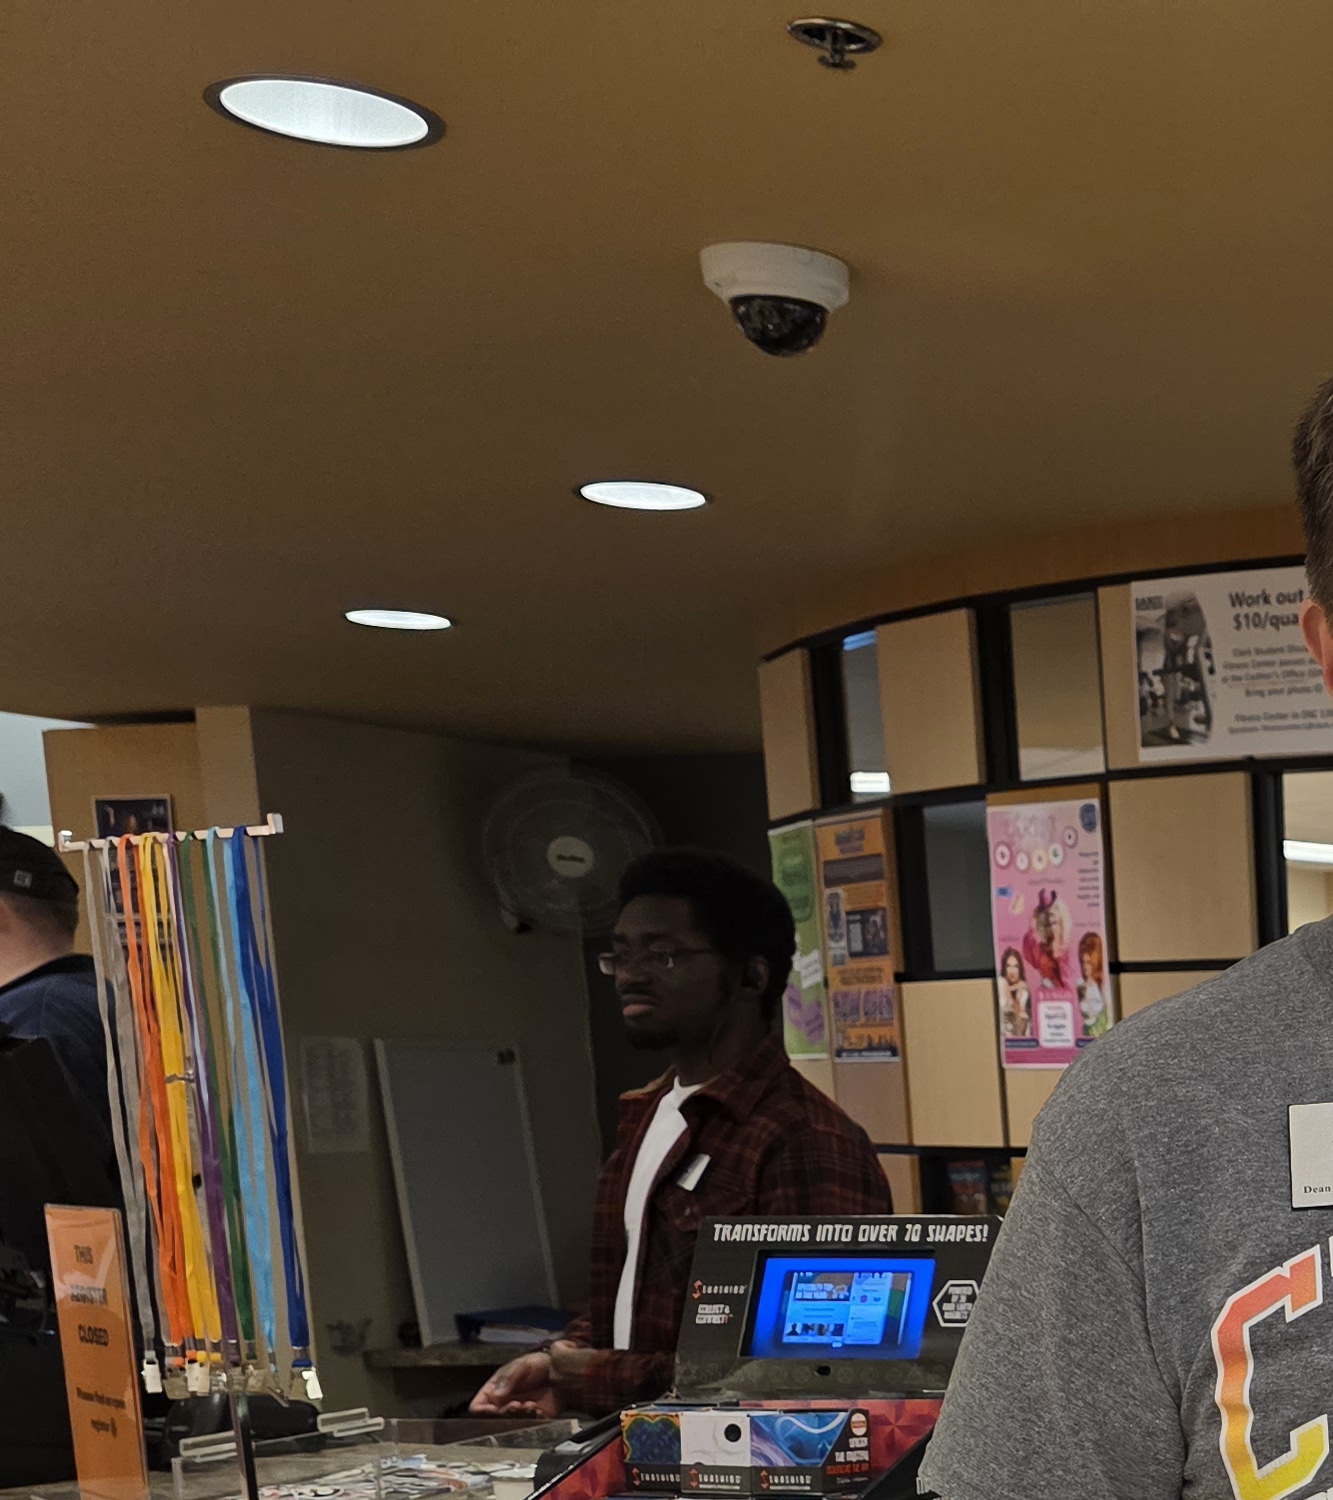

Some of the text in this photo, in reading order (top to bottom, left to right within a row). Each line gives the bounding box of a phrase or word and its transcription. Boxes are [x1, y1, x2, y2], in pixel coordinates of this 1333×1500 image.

[1228, 588, 1304, 608] Work out
[1303, 1185, 1331, 1194] Dean
[713, 1223, 989, 1242] TRANSFORMS INTO OVER 70 SHAPES!
[78, 1323, 109, 1347] CLOSED
